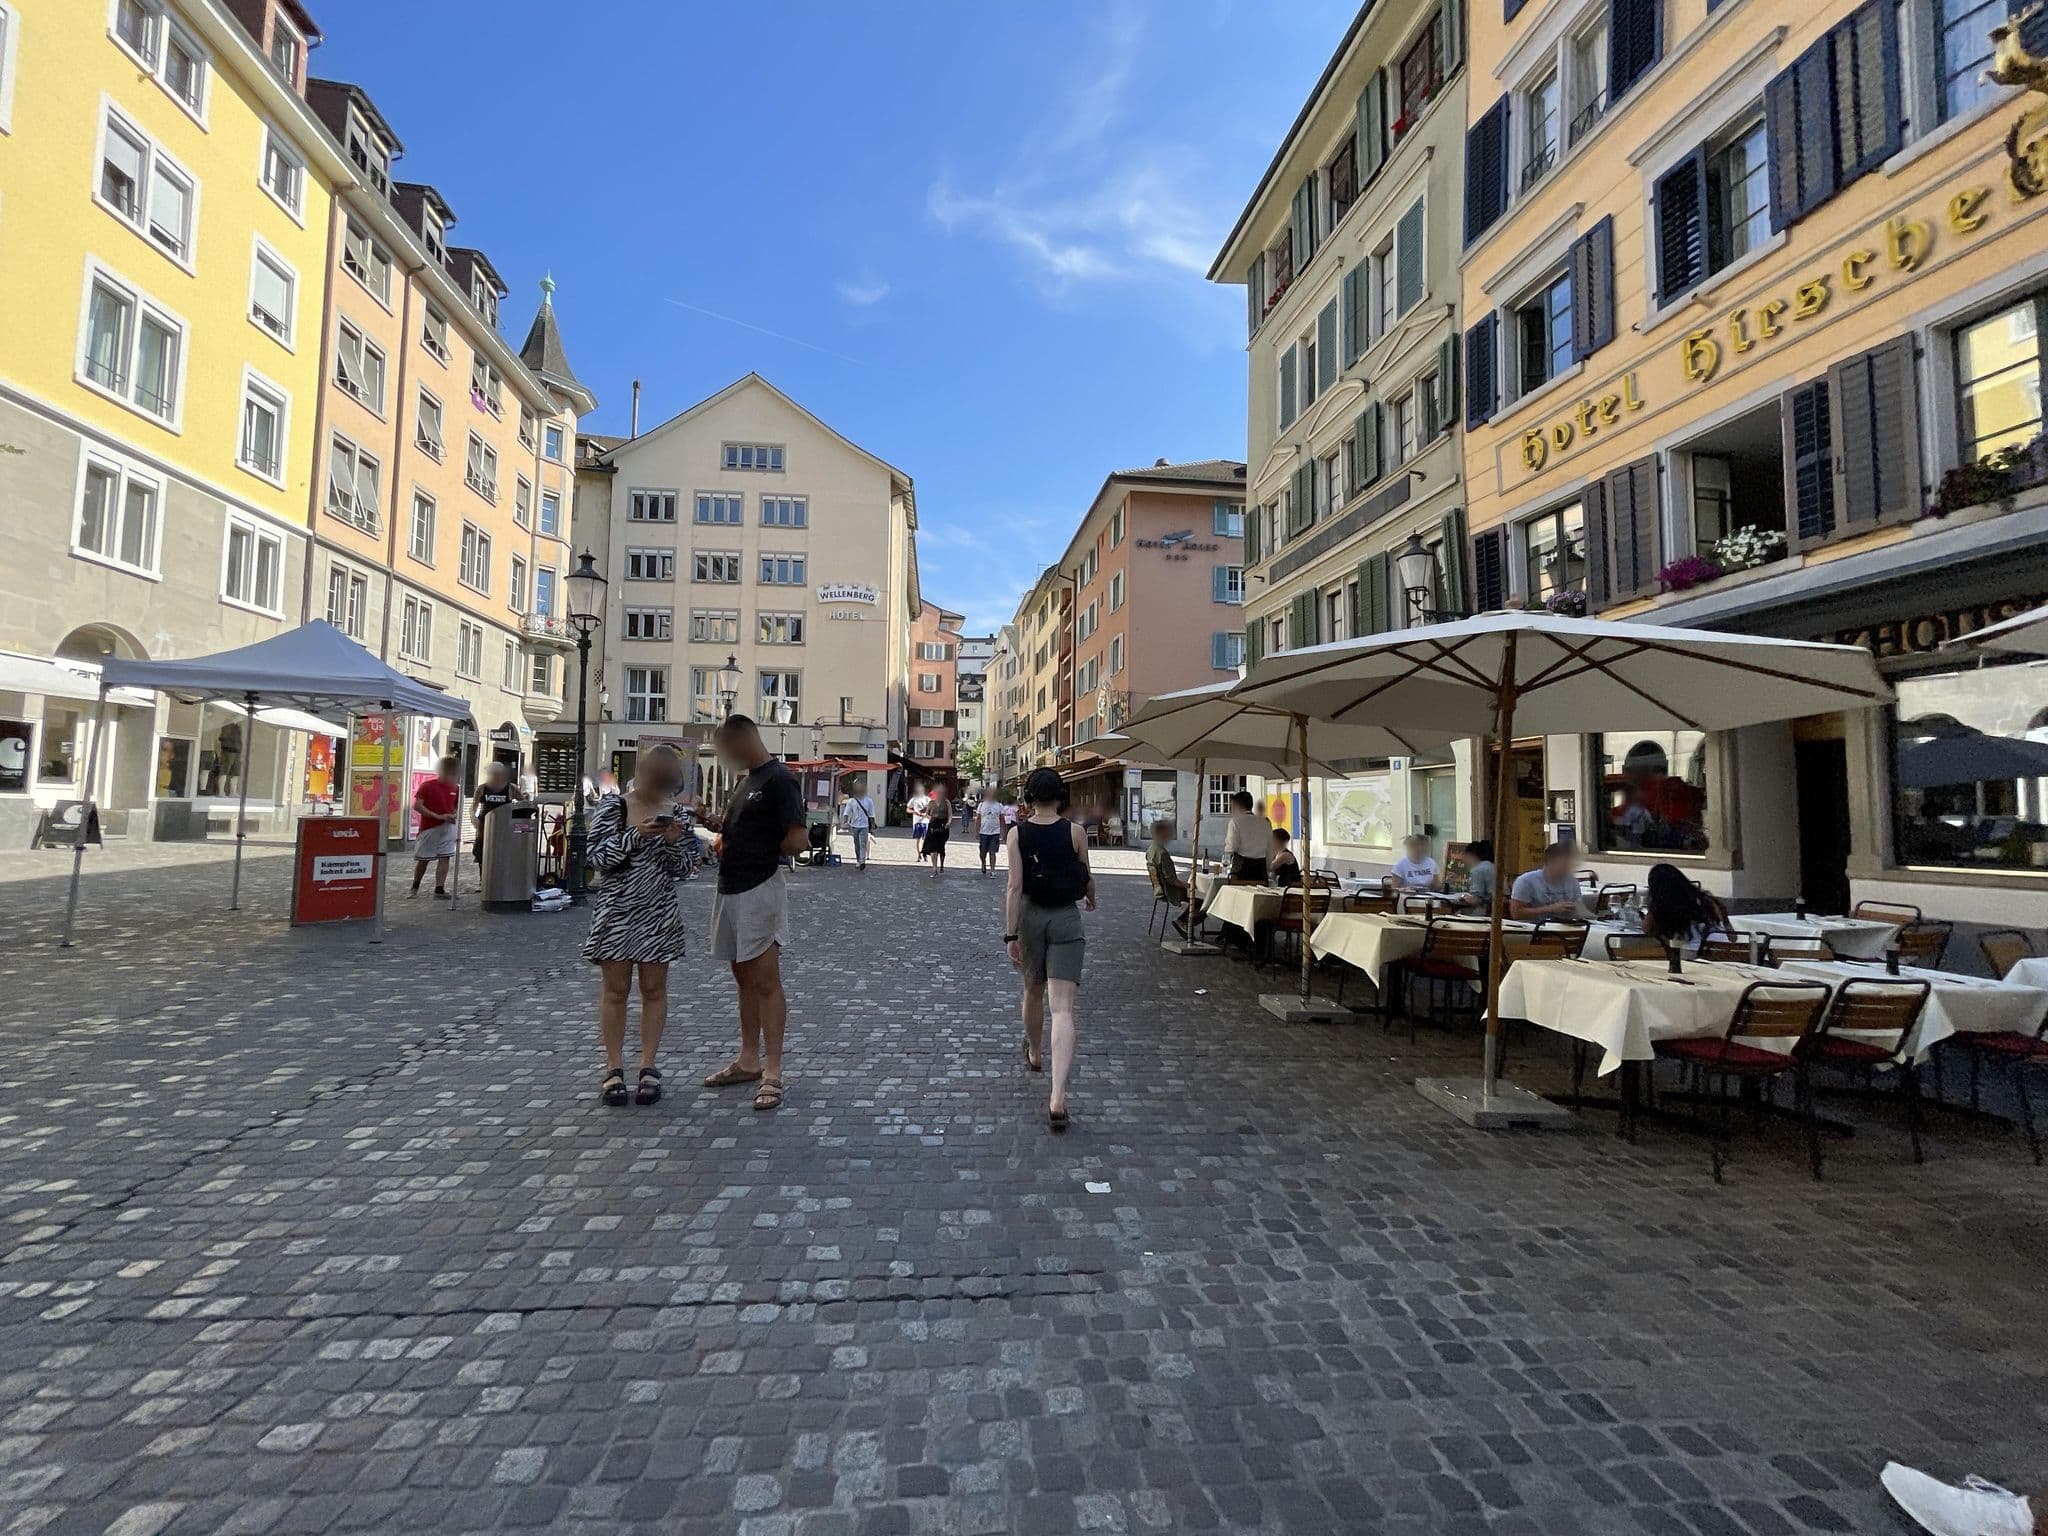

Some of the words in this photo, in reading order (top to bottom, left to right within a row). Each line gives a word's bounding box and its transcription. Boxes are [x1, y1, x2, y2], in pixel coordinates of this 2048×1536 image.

[1521, 370, 1645, 471] Hotel
[819, 590, 875, 602] WELLENBERG
[829, 610, 865, 621] HOTEL
